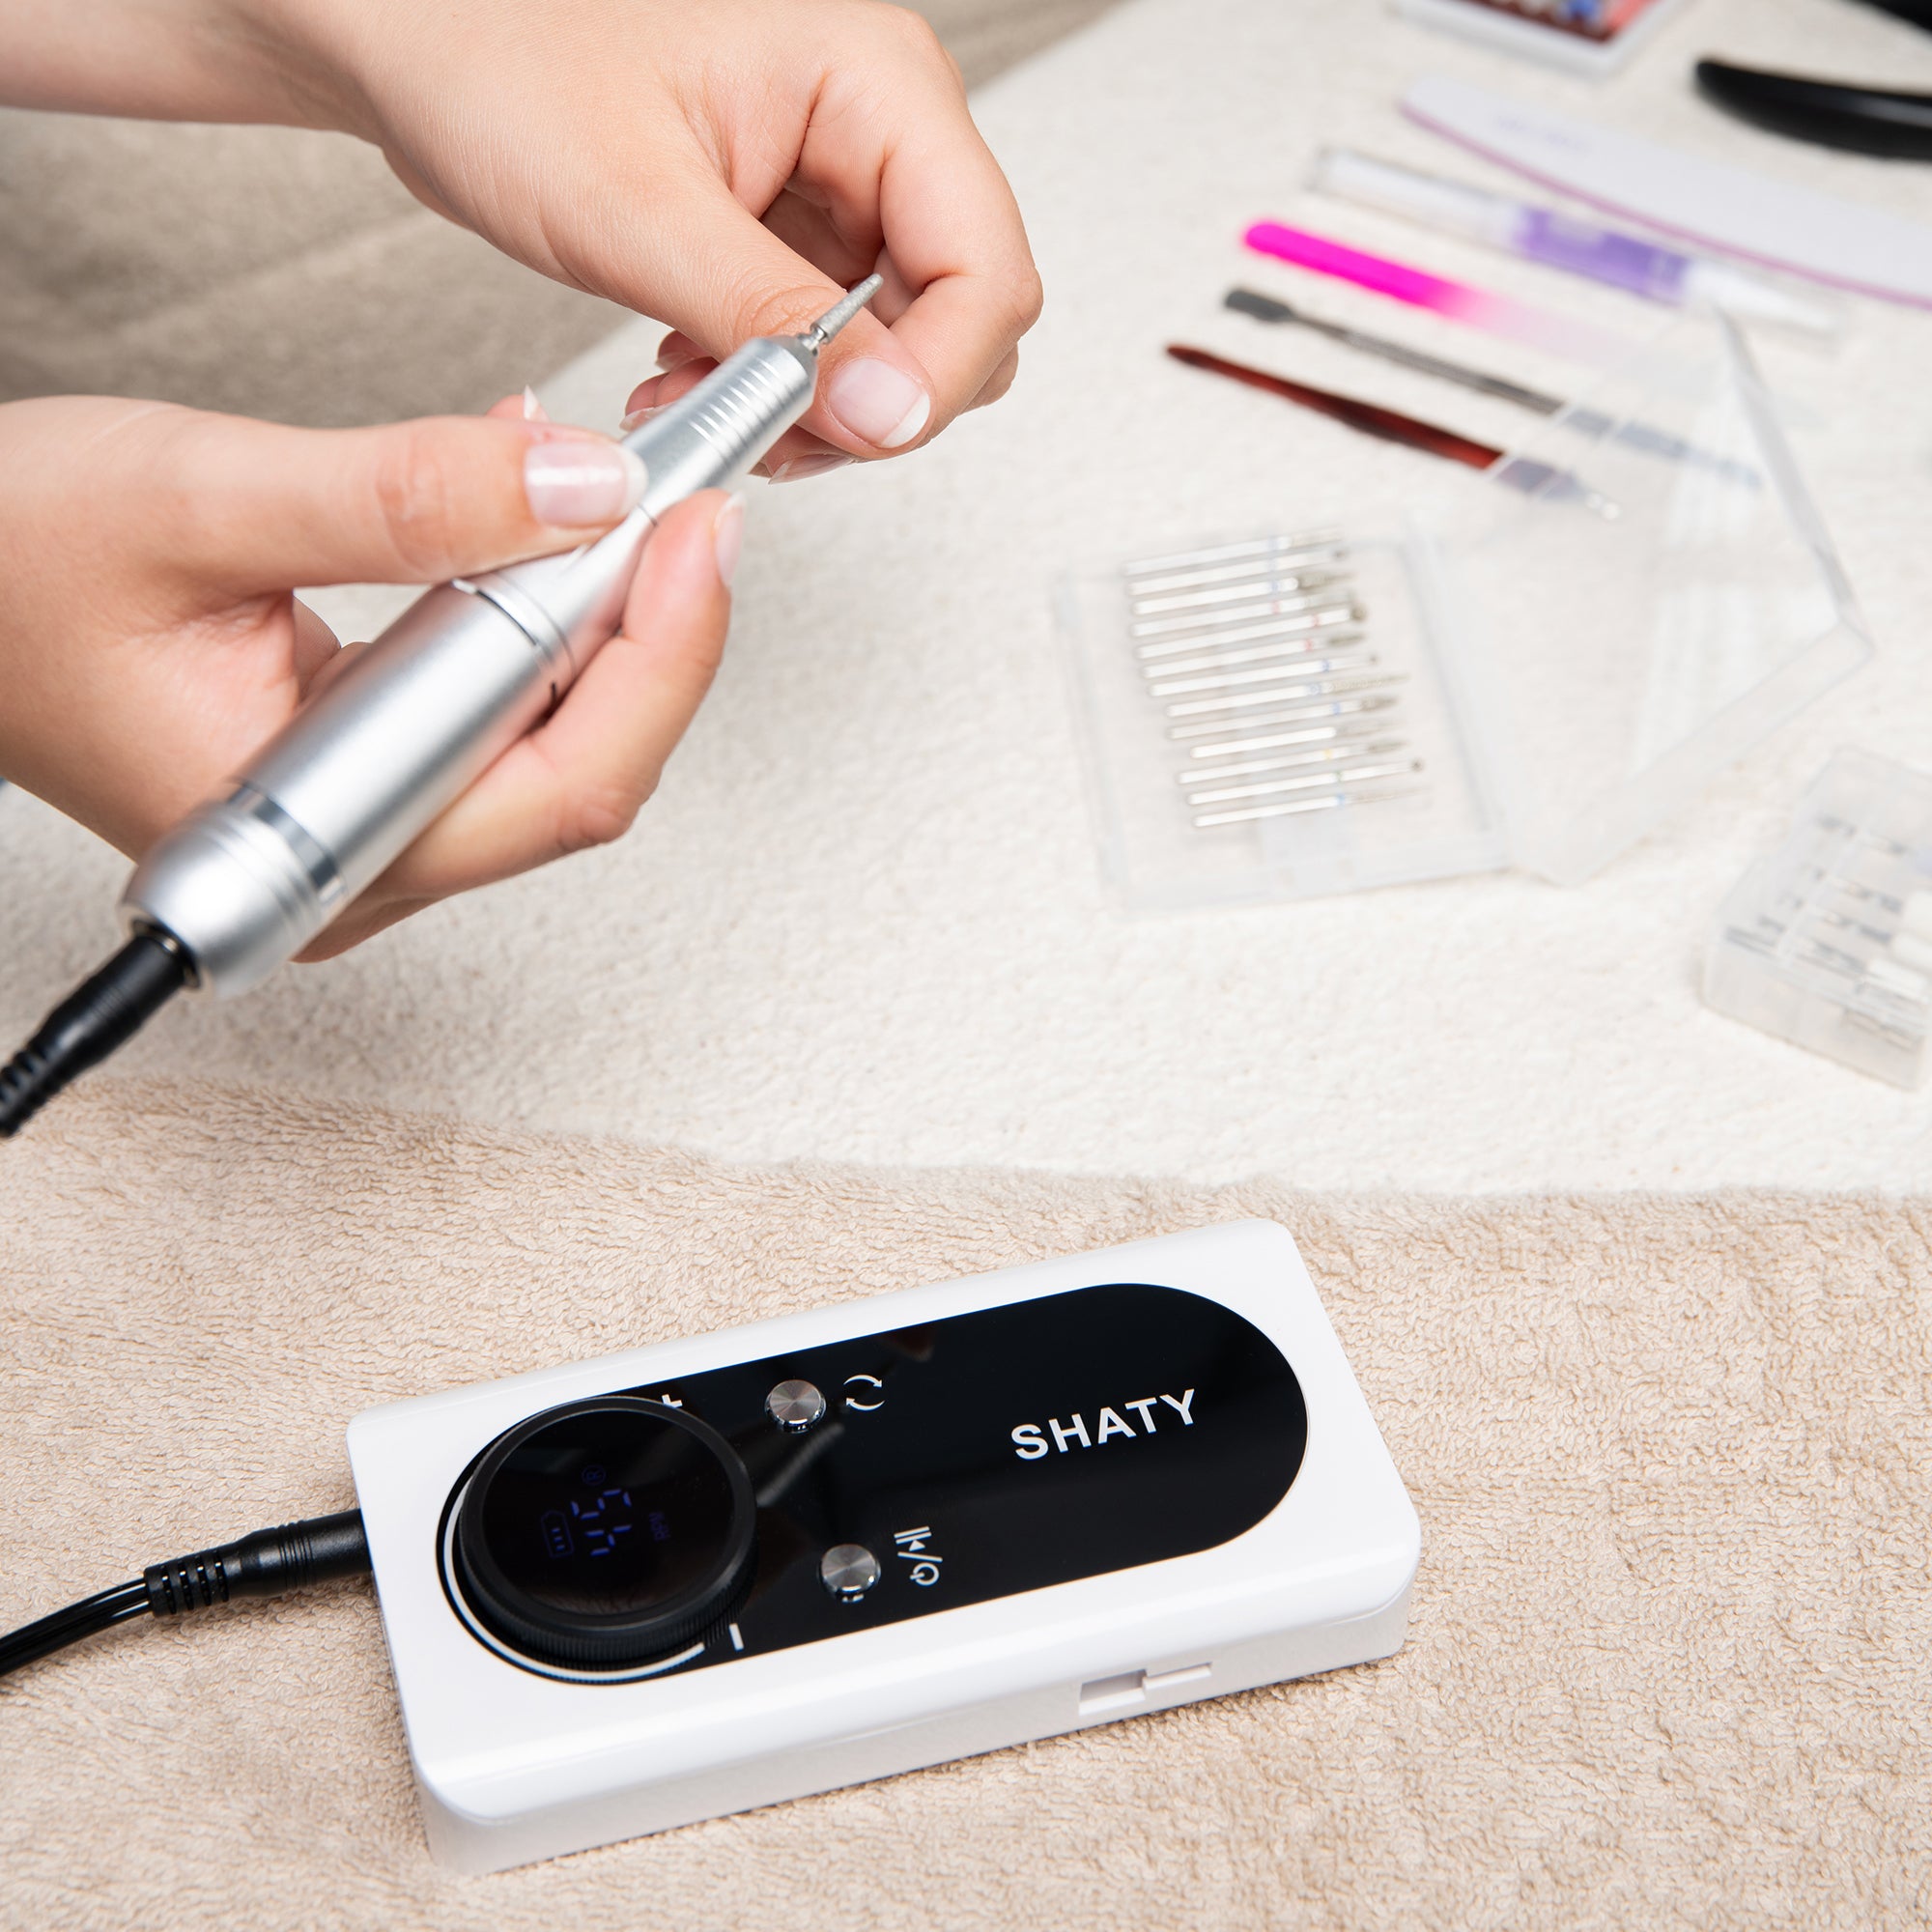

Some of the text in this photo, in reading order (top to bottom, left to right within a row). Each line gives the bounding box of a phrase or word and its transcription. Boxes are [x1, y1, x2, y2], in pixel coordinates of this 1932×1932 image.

[1010, 1388, 1195, 1461] SHATY
[570, 1488, 633, 1557] 45
[648, 1511, 670, 1542] RPM
